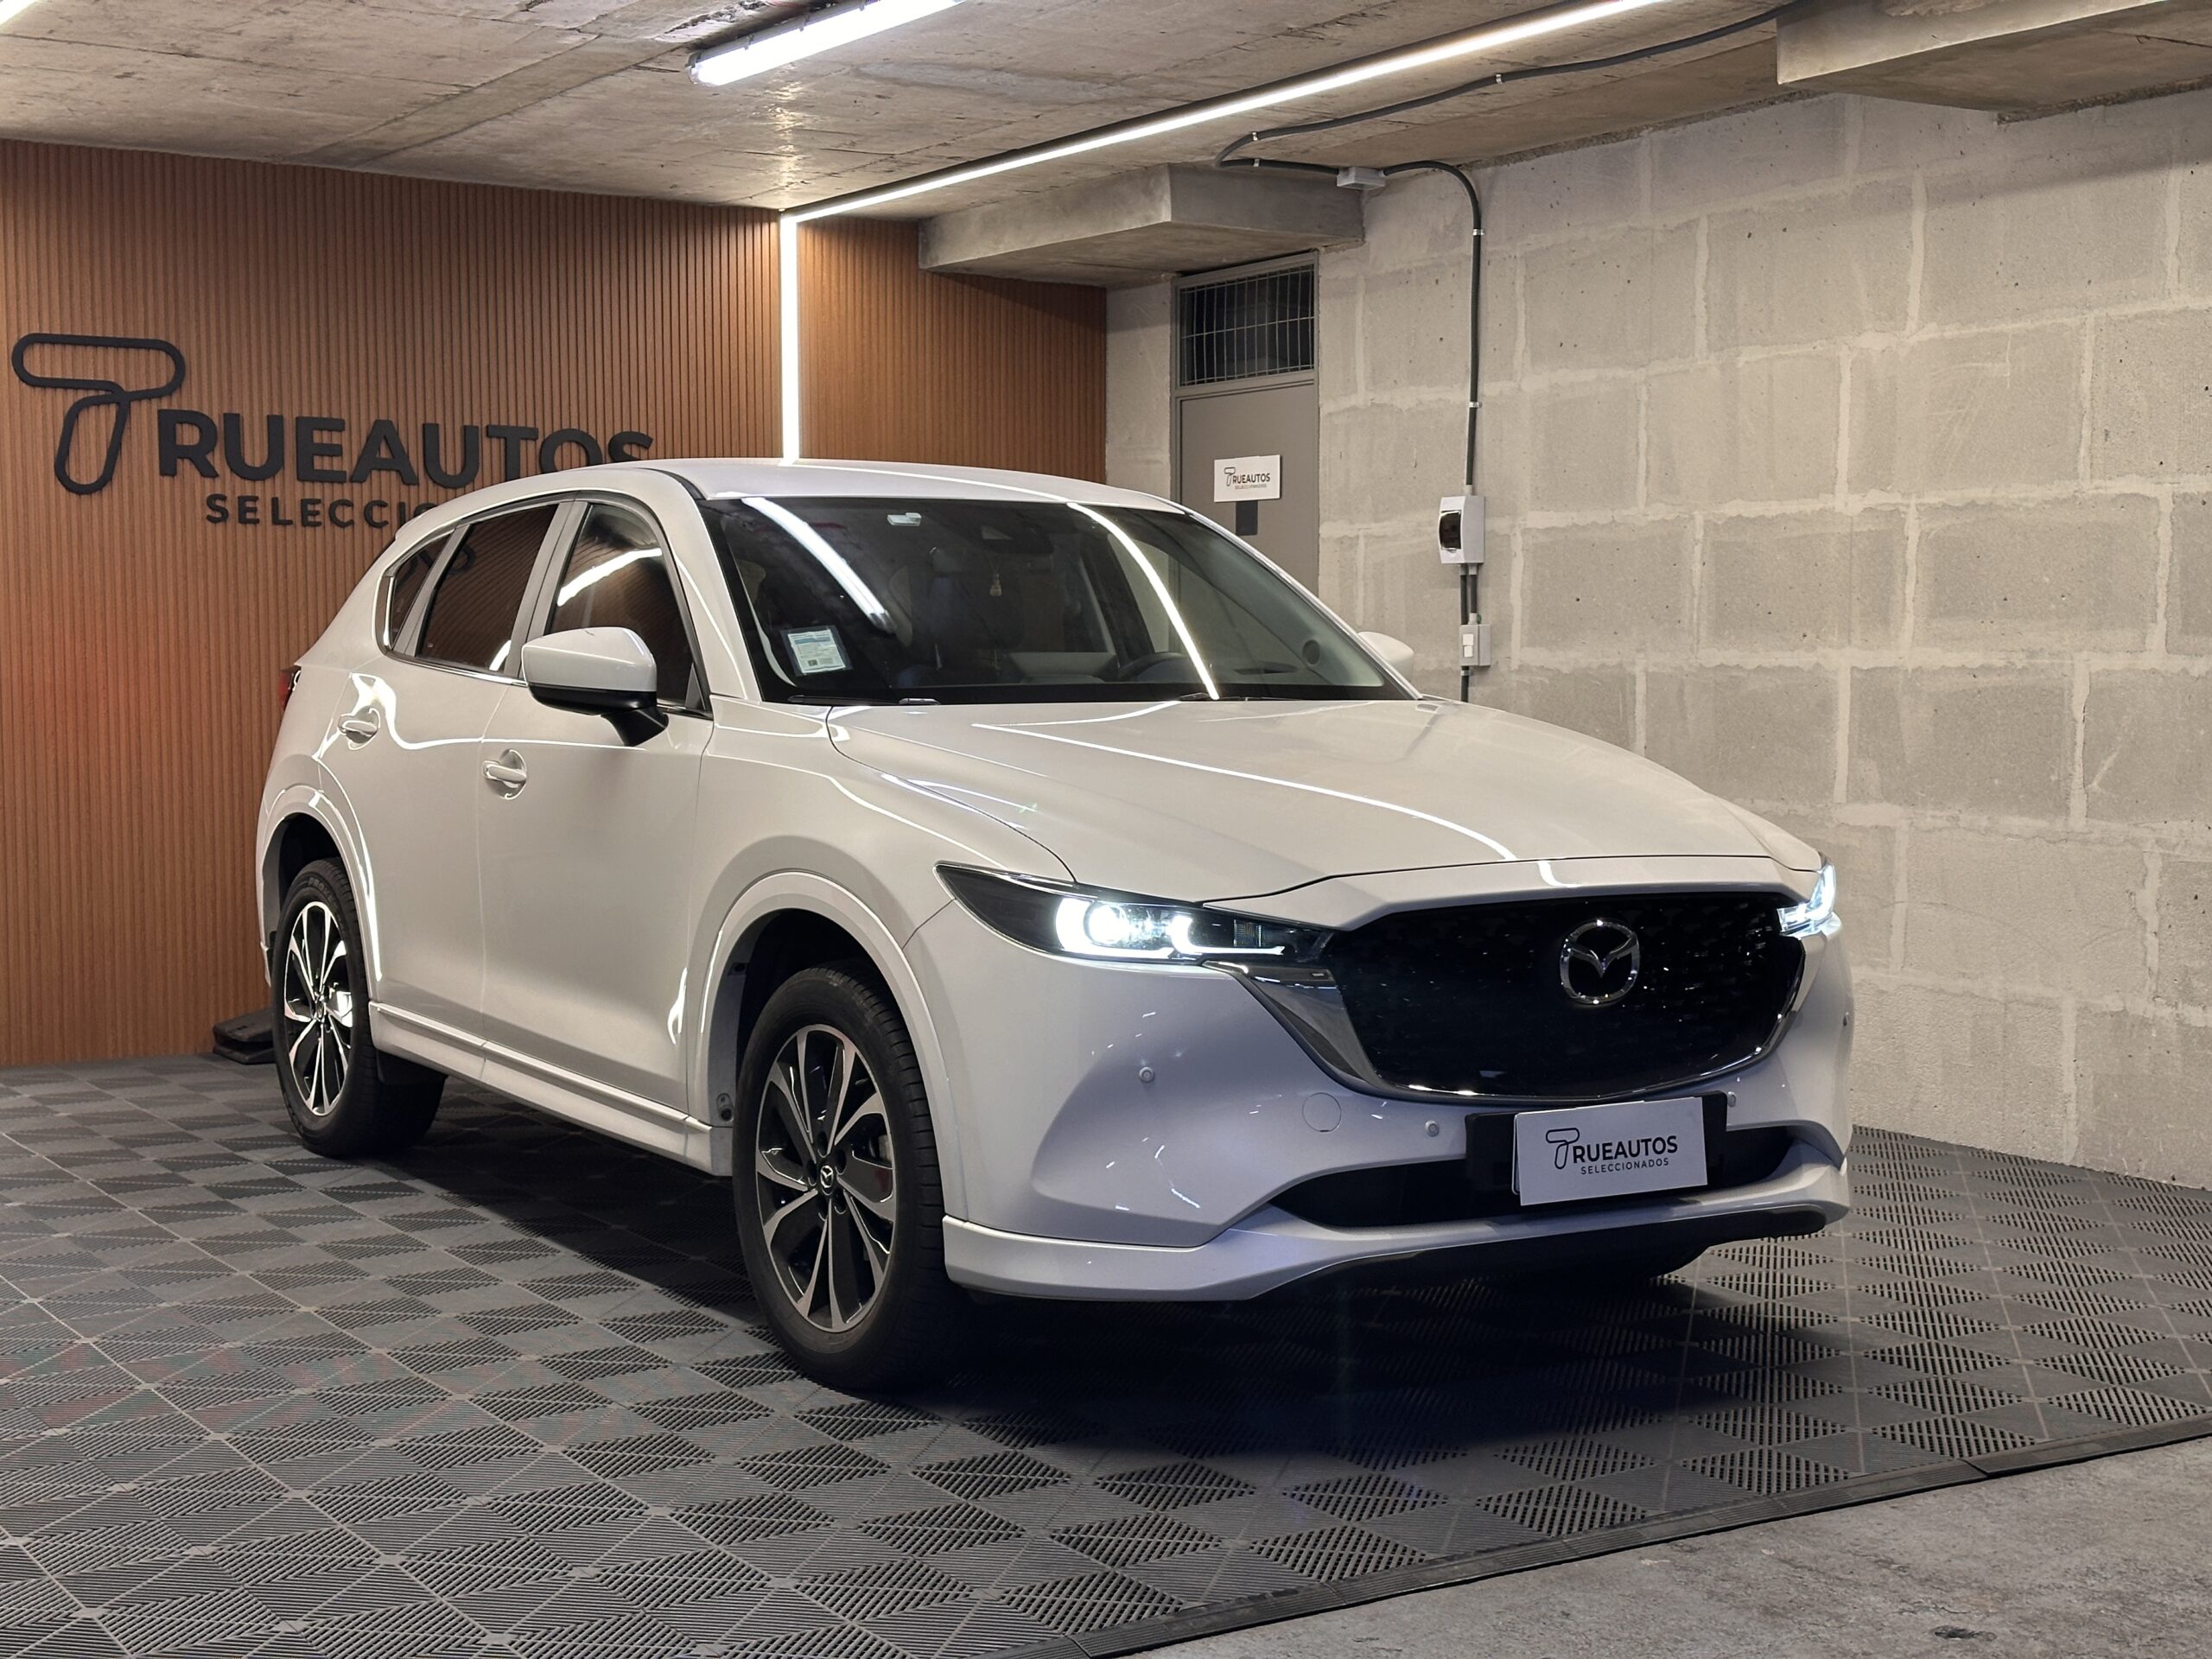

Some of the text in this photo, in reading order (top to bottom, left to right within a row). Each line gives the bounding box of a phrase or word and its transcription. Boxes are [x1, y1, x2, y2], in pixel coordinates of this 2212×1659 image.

[206, 493, 438, 528] SELECCI
[1546, 1128, 1678, 1169] TRUEAUTOS
[1581, 1158, 1669, 1174] SELECCIONADOS
